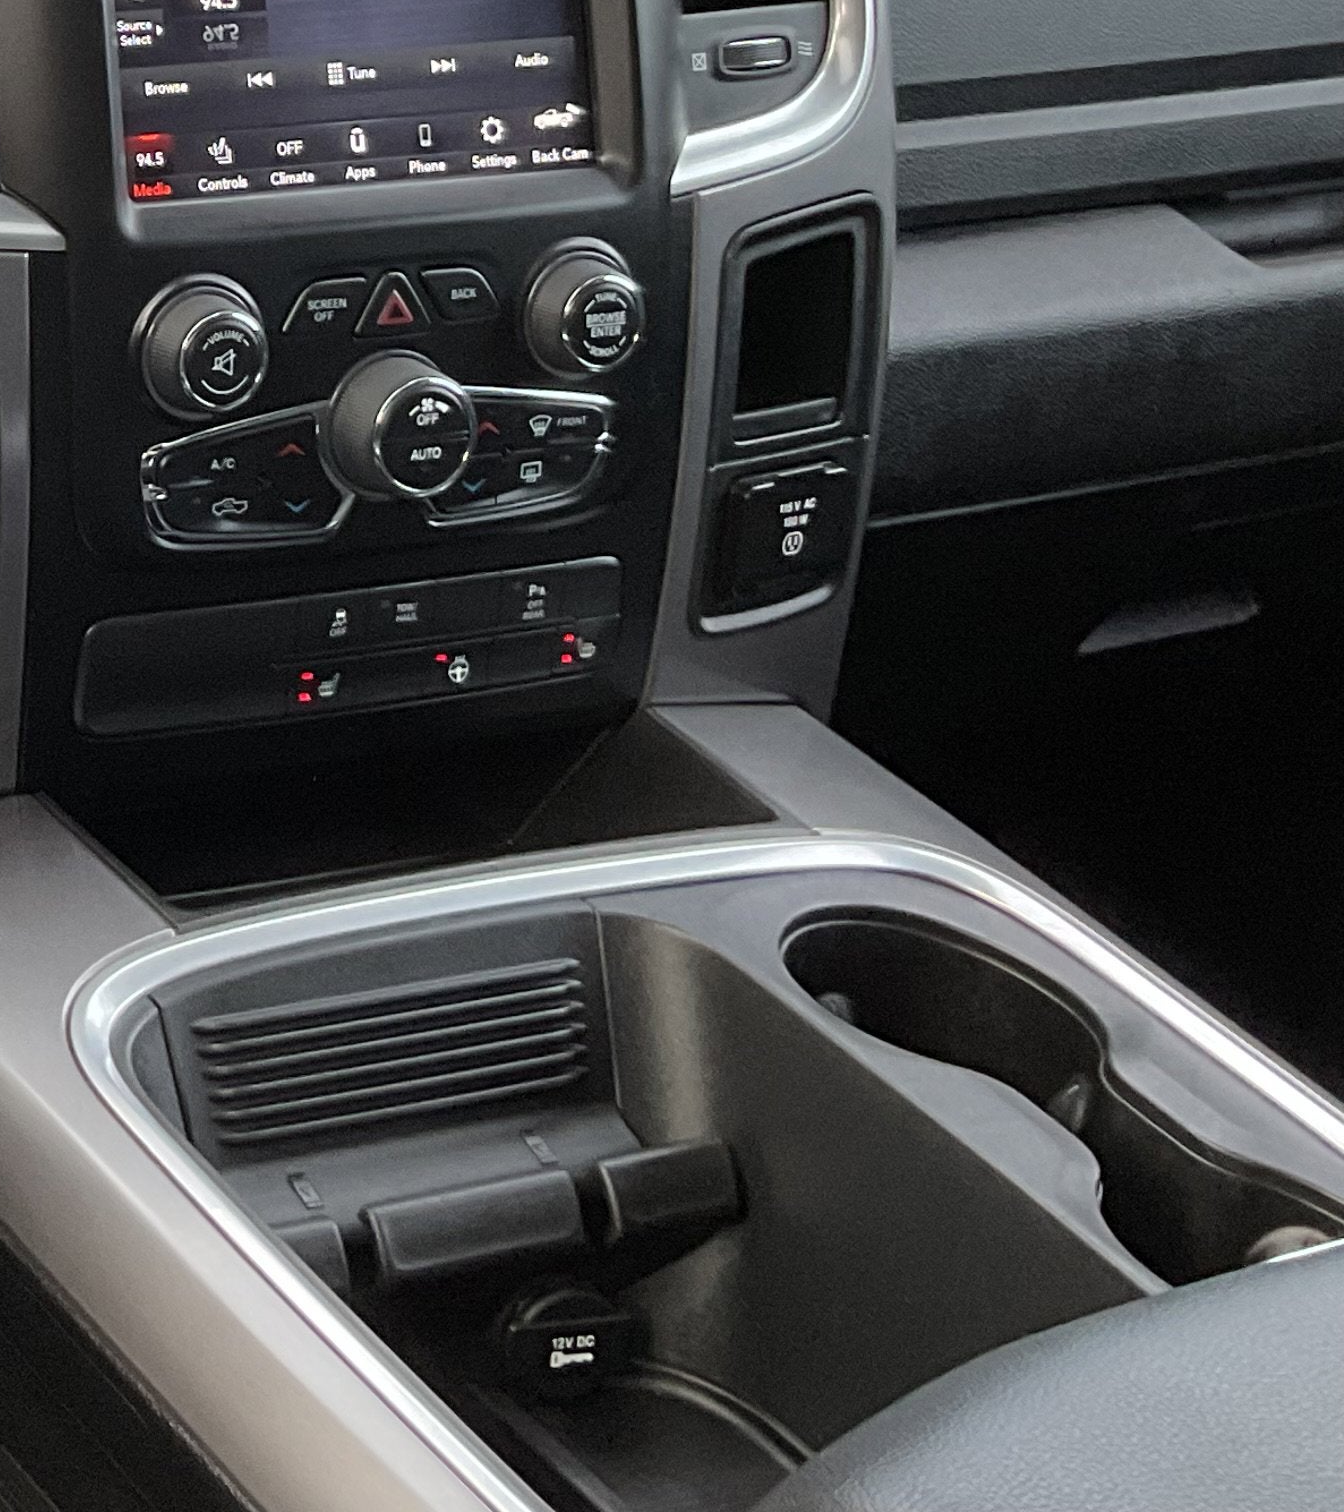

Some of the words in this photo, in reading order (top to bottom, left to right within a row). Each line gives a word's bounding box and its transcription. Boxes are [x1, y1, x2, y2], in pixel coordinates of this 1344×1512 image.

[116, 20, 153, 33] Source
[119, 34, 152, 47] Select
[514, 51, 548, 68] Audio
[347, 65, 377, 81] Tune
[144, 81, 189, 96] Browse
[276, 140, 303, 156] OFF
[532, 148, 559, 164] Back
[562, 146, 591, 161] Cam
[136, 152, 164, 167] 94.5
[409, 159, 446, 174] Phone
[472, 153, 517, 170] Settings
[270, 170, 315, 186] Climate
[345, 166, 376, 182] Apps
[133, 182, 172, 198] Media
[198, 175, 248, 193] Controls
[451, 288, 478, 300] BACK
[307, 298, 347, 310] SCREEN
[314, 310, 335, 323] OFF
[586, 311, 626, 325] BROWSE
[207, 329, 245, 344] VOLUME
[416, 413, 440, 426] OFF
[557, 416, 587, 426] FRONT
[410, 446, 442, 461] AUTO
[211, 457, 236, 470] A/C
[552, 1337, 574, 1349] 12V
[577, 1335, 595, 1347] DC
